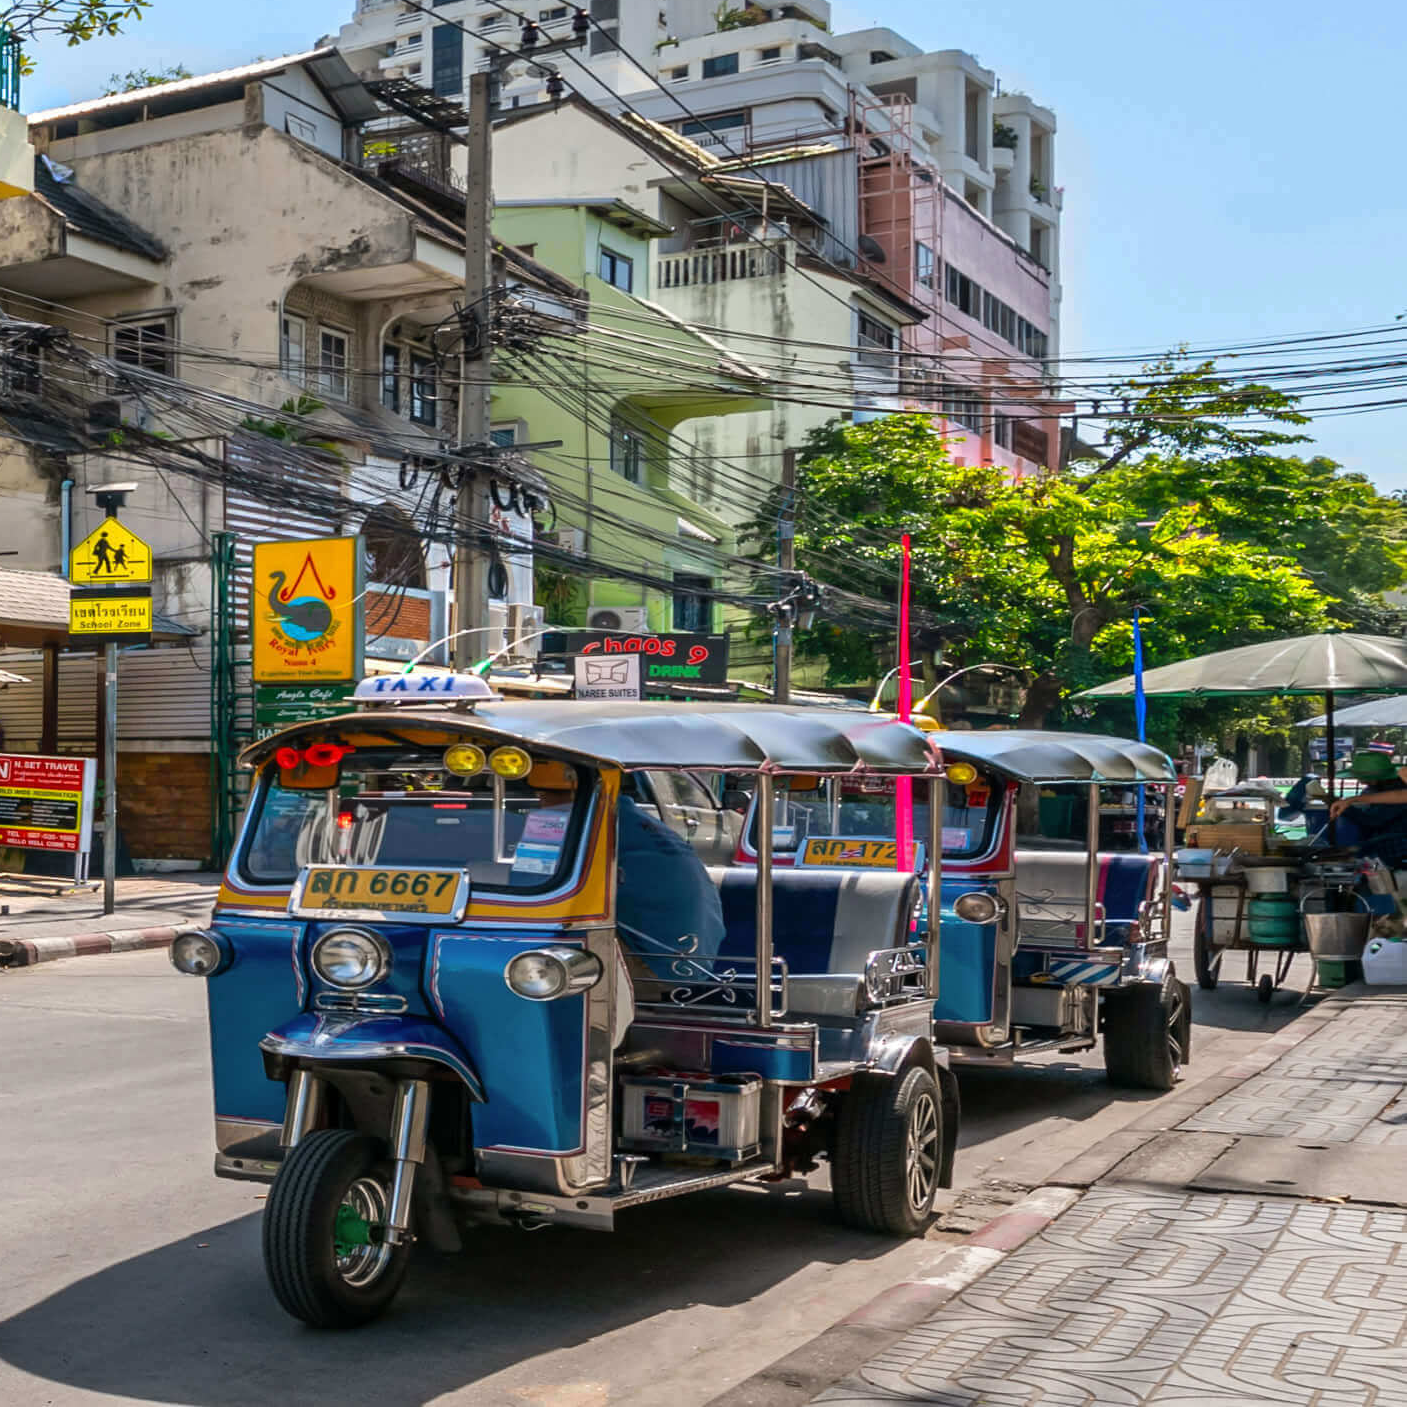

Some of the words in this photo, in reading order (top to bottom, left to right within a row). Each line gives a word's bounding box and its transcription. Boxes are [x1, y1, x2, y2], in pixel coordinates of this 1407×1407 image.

[80, 620, 112, 628] School
[117, 620, 141, 628] Zone
[268, 638, 299, 657] Royal
[687, 645, 709, 665] 9
[649, 665, 701, 678] DRINK
[375, 677, 456, 692] TAXI
[577, 689, 607, 698] NAREE
[608, 689, 638, 698] SUITES
[44, 762, 80, 771] TRAVEL
[858, 842, 898, 859] 172
[370, 872, 454, 898] 6667
